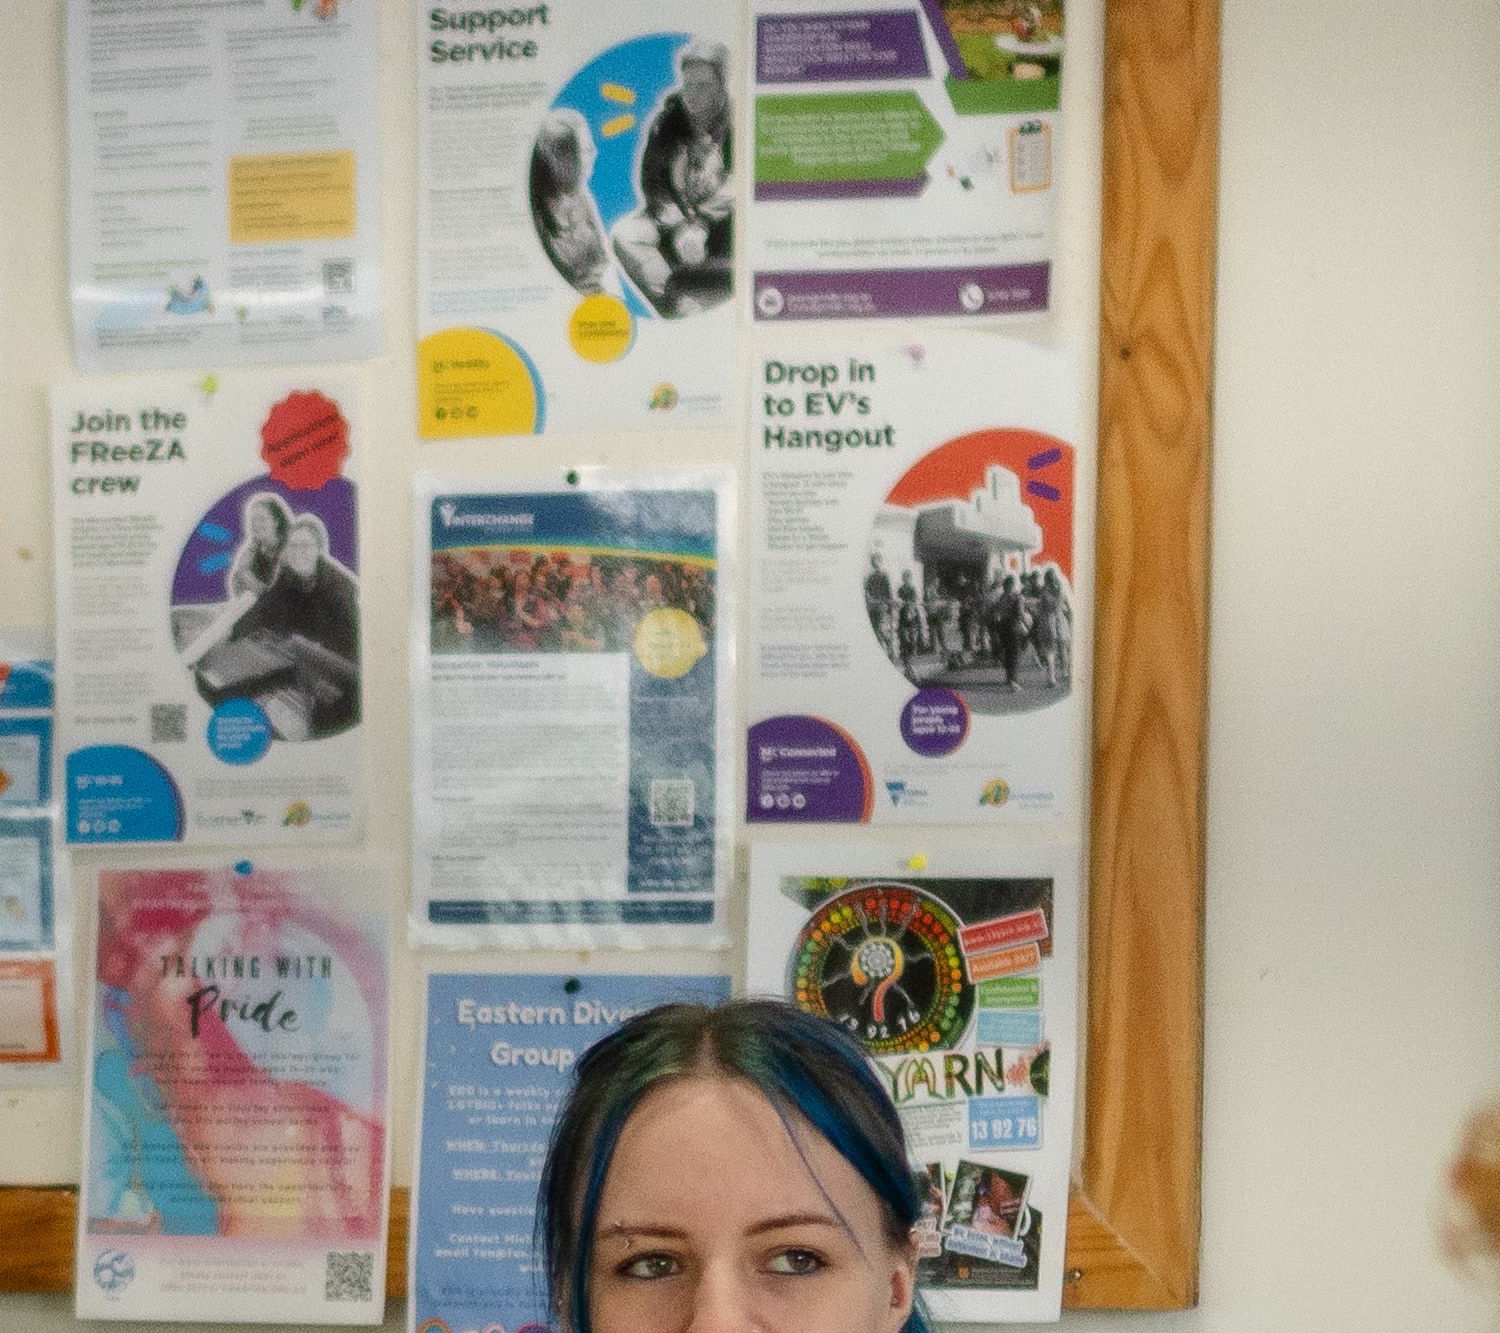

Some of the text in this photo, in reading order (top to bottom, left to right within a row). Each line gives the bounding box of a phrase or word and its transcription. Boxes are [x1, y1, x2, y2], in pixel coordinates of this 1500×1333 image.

[429, 4, 549, 34] Support
[430, 38, 538, 64] Service
[764, 358, 876, 389] Drop in
[764, 392, 871, 416] to EV's
[71, 406, 187, 435] Join the
[764, 425, 895, 453] Hangout
[71, 440, 187, 466] FReeZA
[71, 474, 139, 496] crew
[161, 955, 333, 978] TALKING WITH
[187, 984, 300, 1038] Pride
[458, 999, 641, 1025] Eastern Dive
[491, 1041, 576, 1074] Group
[971, 1120, 989, 1140] 13
